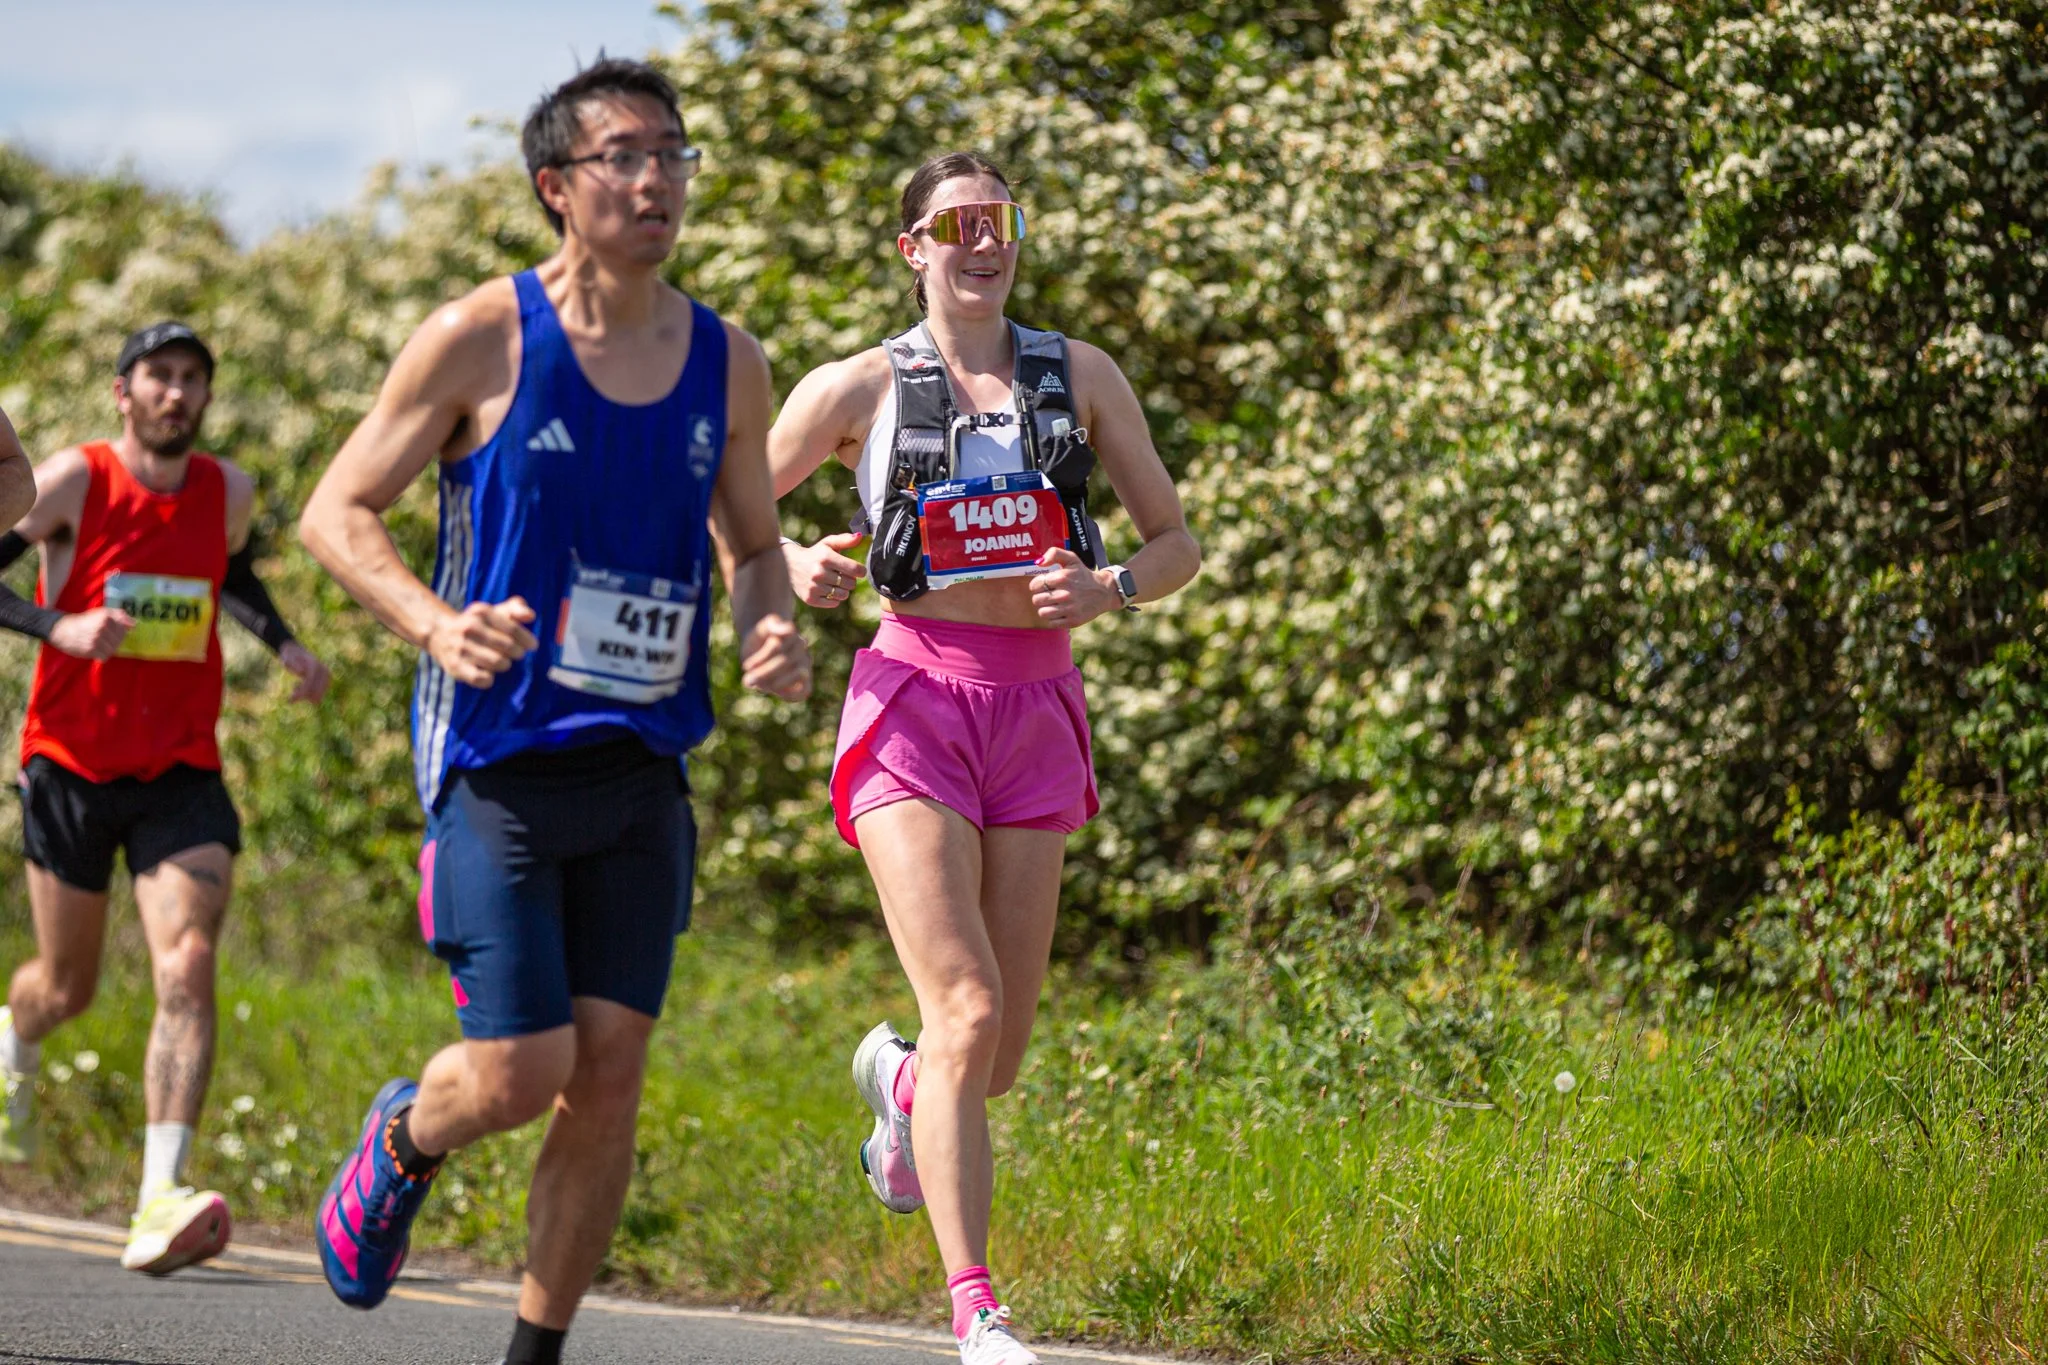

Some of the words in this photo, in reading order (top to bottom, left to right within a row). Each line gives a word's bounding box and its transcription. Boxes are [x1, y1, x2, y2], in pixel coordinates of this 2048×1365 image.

[949, 494, 1038, 532] 1409
[1069, 506, 1089, 552] AONIJIE
[896, 514, 916, 557] AONIJIE
[964, 532, 1034, 555] JOANNA
[615, 600, 682, 642] 411
